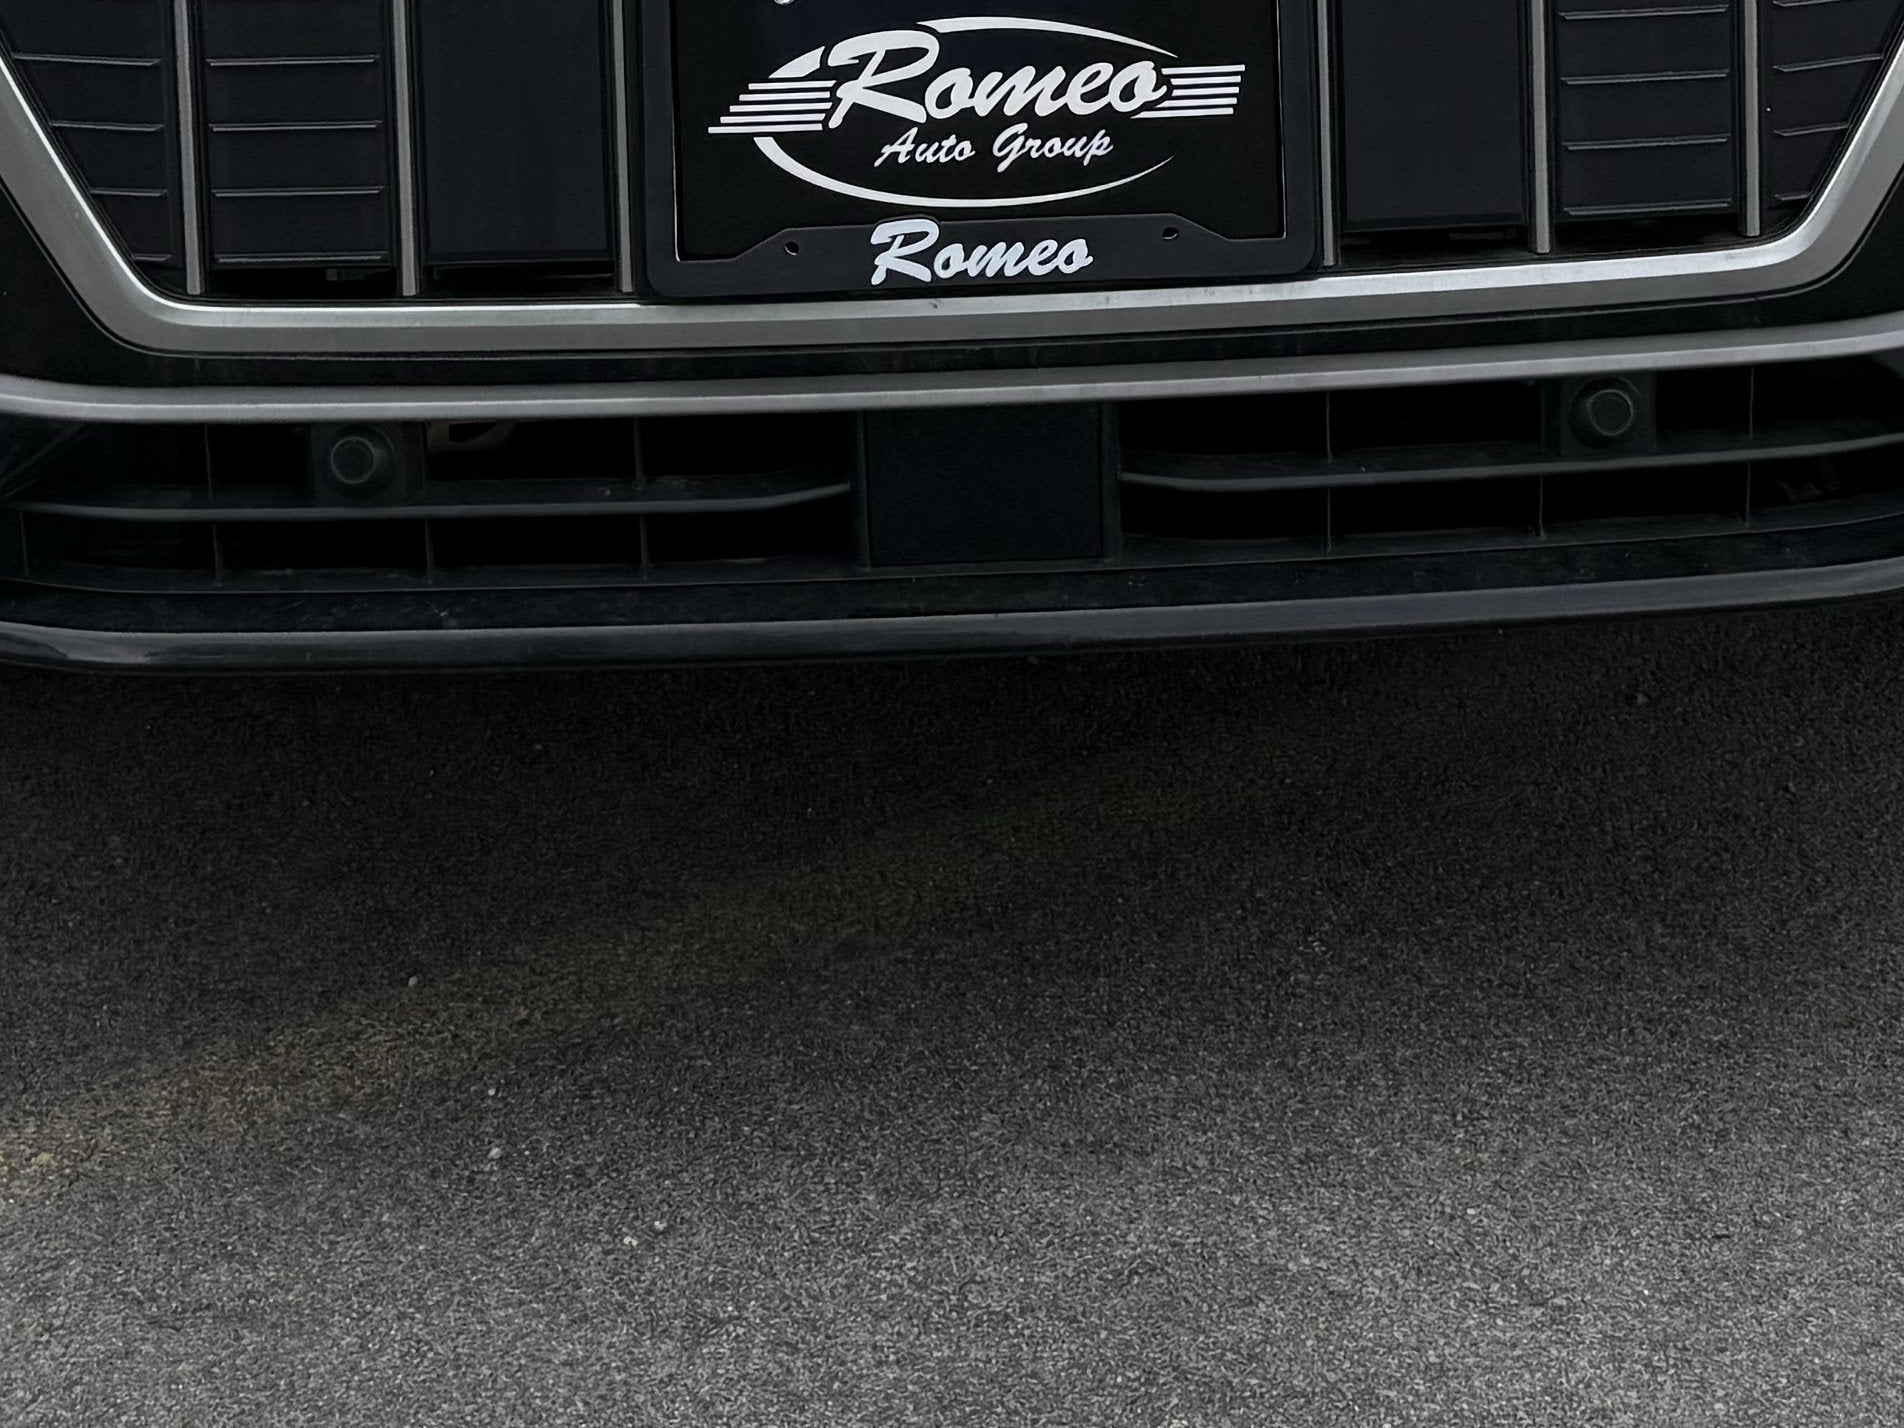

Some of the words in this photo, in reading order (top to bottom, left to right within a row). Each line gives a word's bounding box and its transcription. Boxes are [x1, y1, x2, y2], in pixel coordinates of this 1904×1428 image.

[827, 30, 1168, 129] Romeo
[873, 126, 976, 167] Auto
[992, 122, 1114, 173] Group
[870, 218, 1094, 286] Romeo
